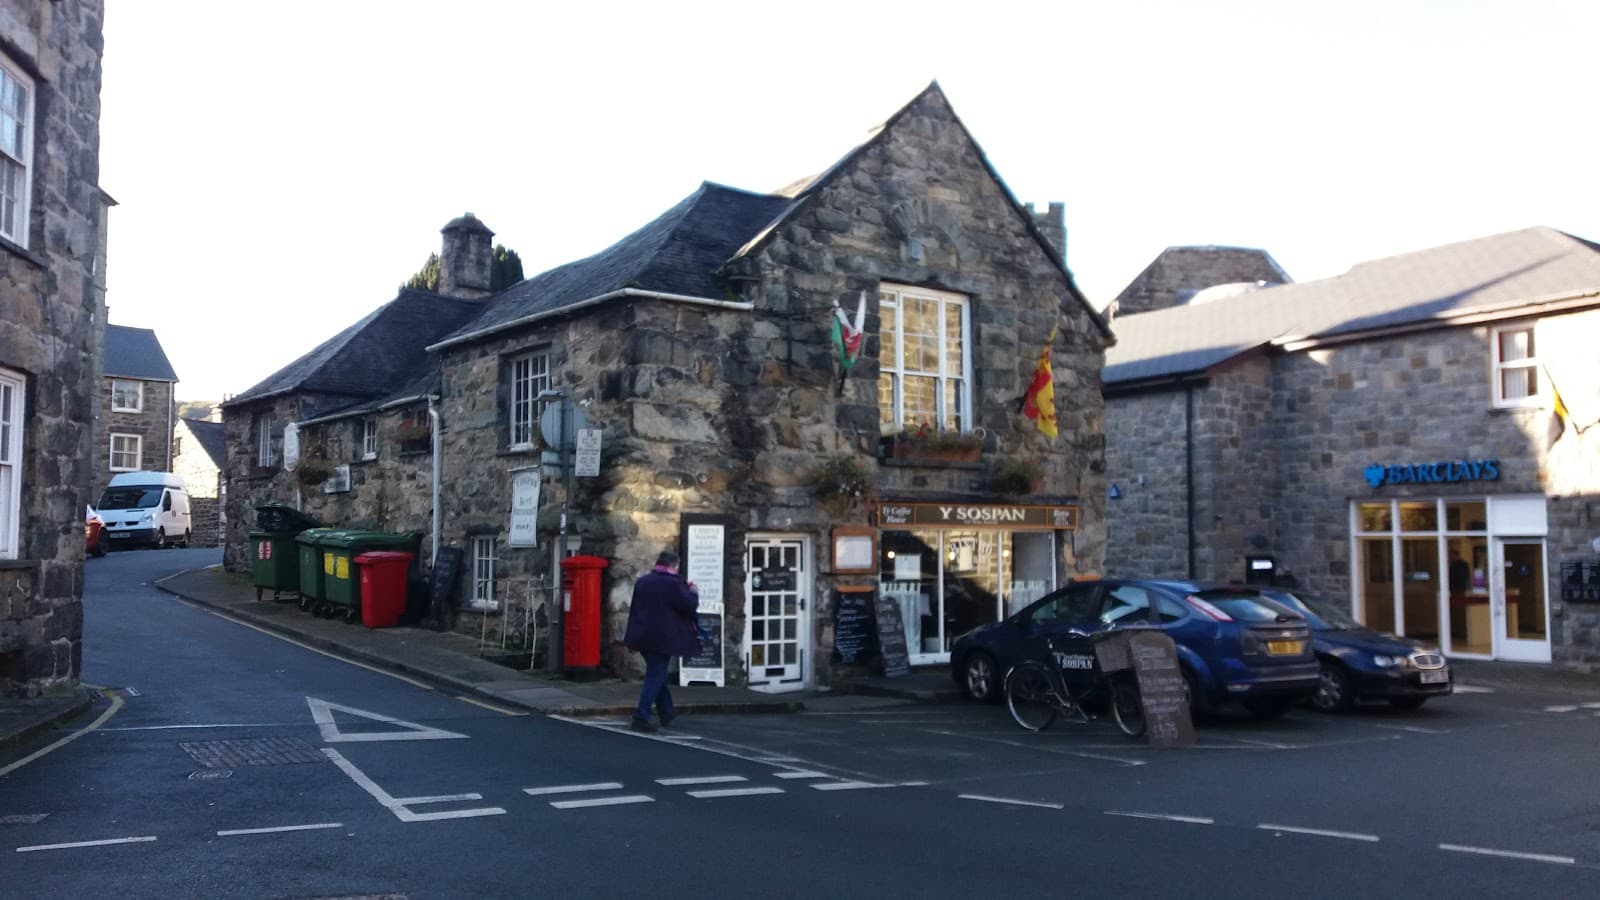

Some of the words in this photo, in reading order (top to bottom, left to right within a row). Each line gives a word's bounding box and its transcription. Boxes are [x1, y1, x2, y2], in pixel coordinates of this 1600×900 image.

[1387, 460, 1499, 484] BARCLAYS
[939, 506, 952, 520] Y
[956, 507, 1026, 521] SOSPAN
